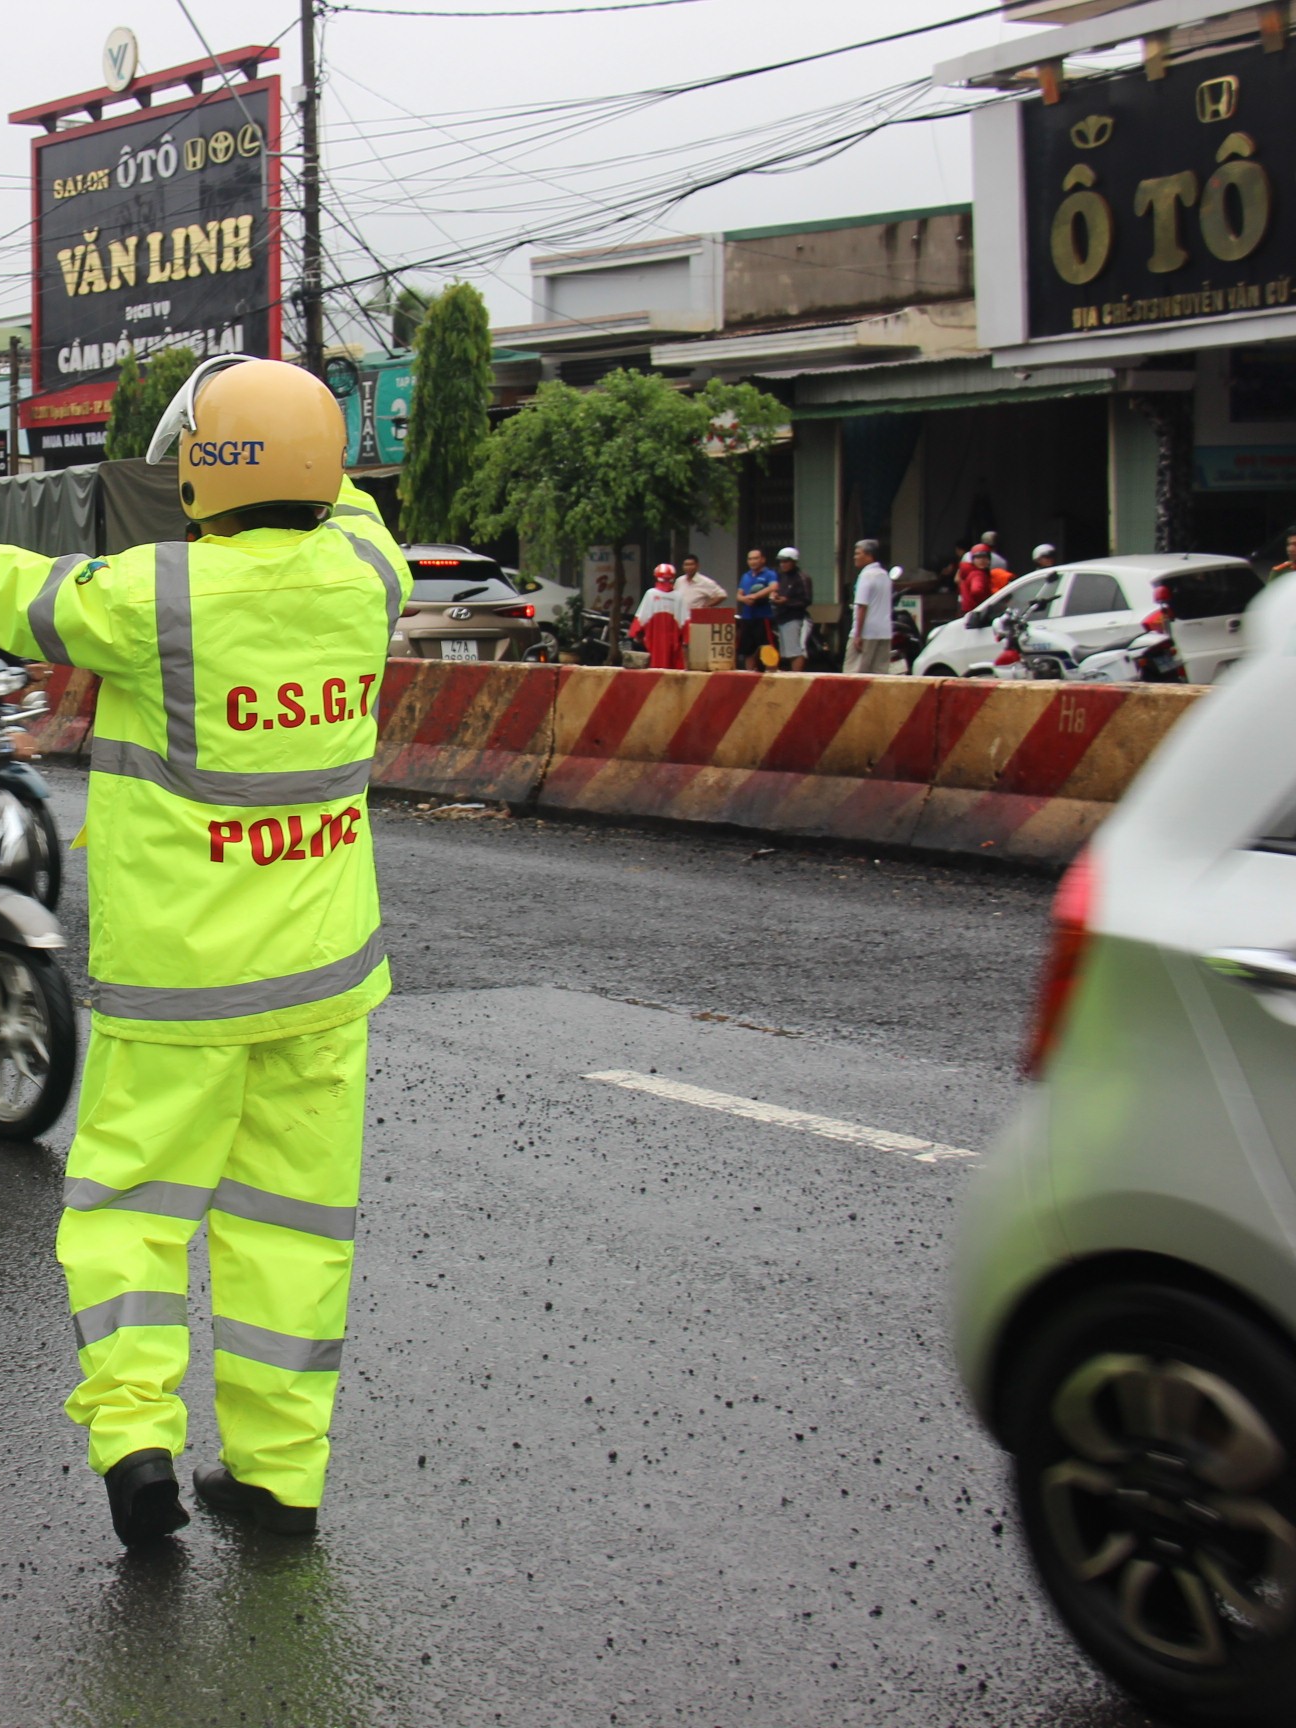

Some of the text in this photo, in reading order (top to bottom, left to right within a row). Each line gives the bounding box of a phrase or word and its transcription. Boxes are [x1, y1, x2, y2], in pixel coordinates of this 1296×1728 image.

[54, 168, 110, 199] SALON
[1050, 163, 1113, 285] Ô
[57, 214, 253, 297] VĂN LINH
[42, 435, 63, 449] MUA
[189, 441, 264, 467] CSGT
[711, 623, 734, 642] H8
